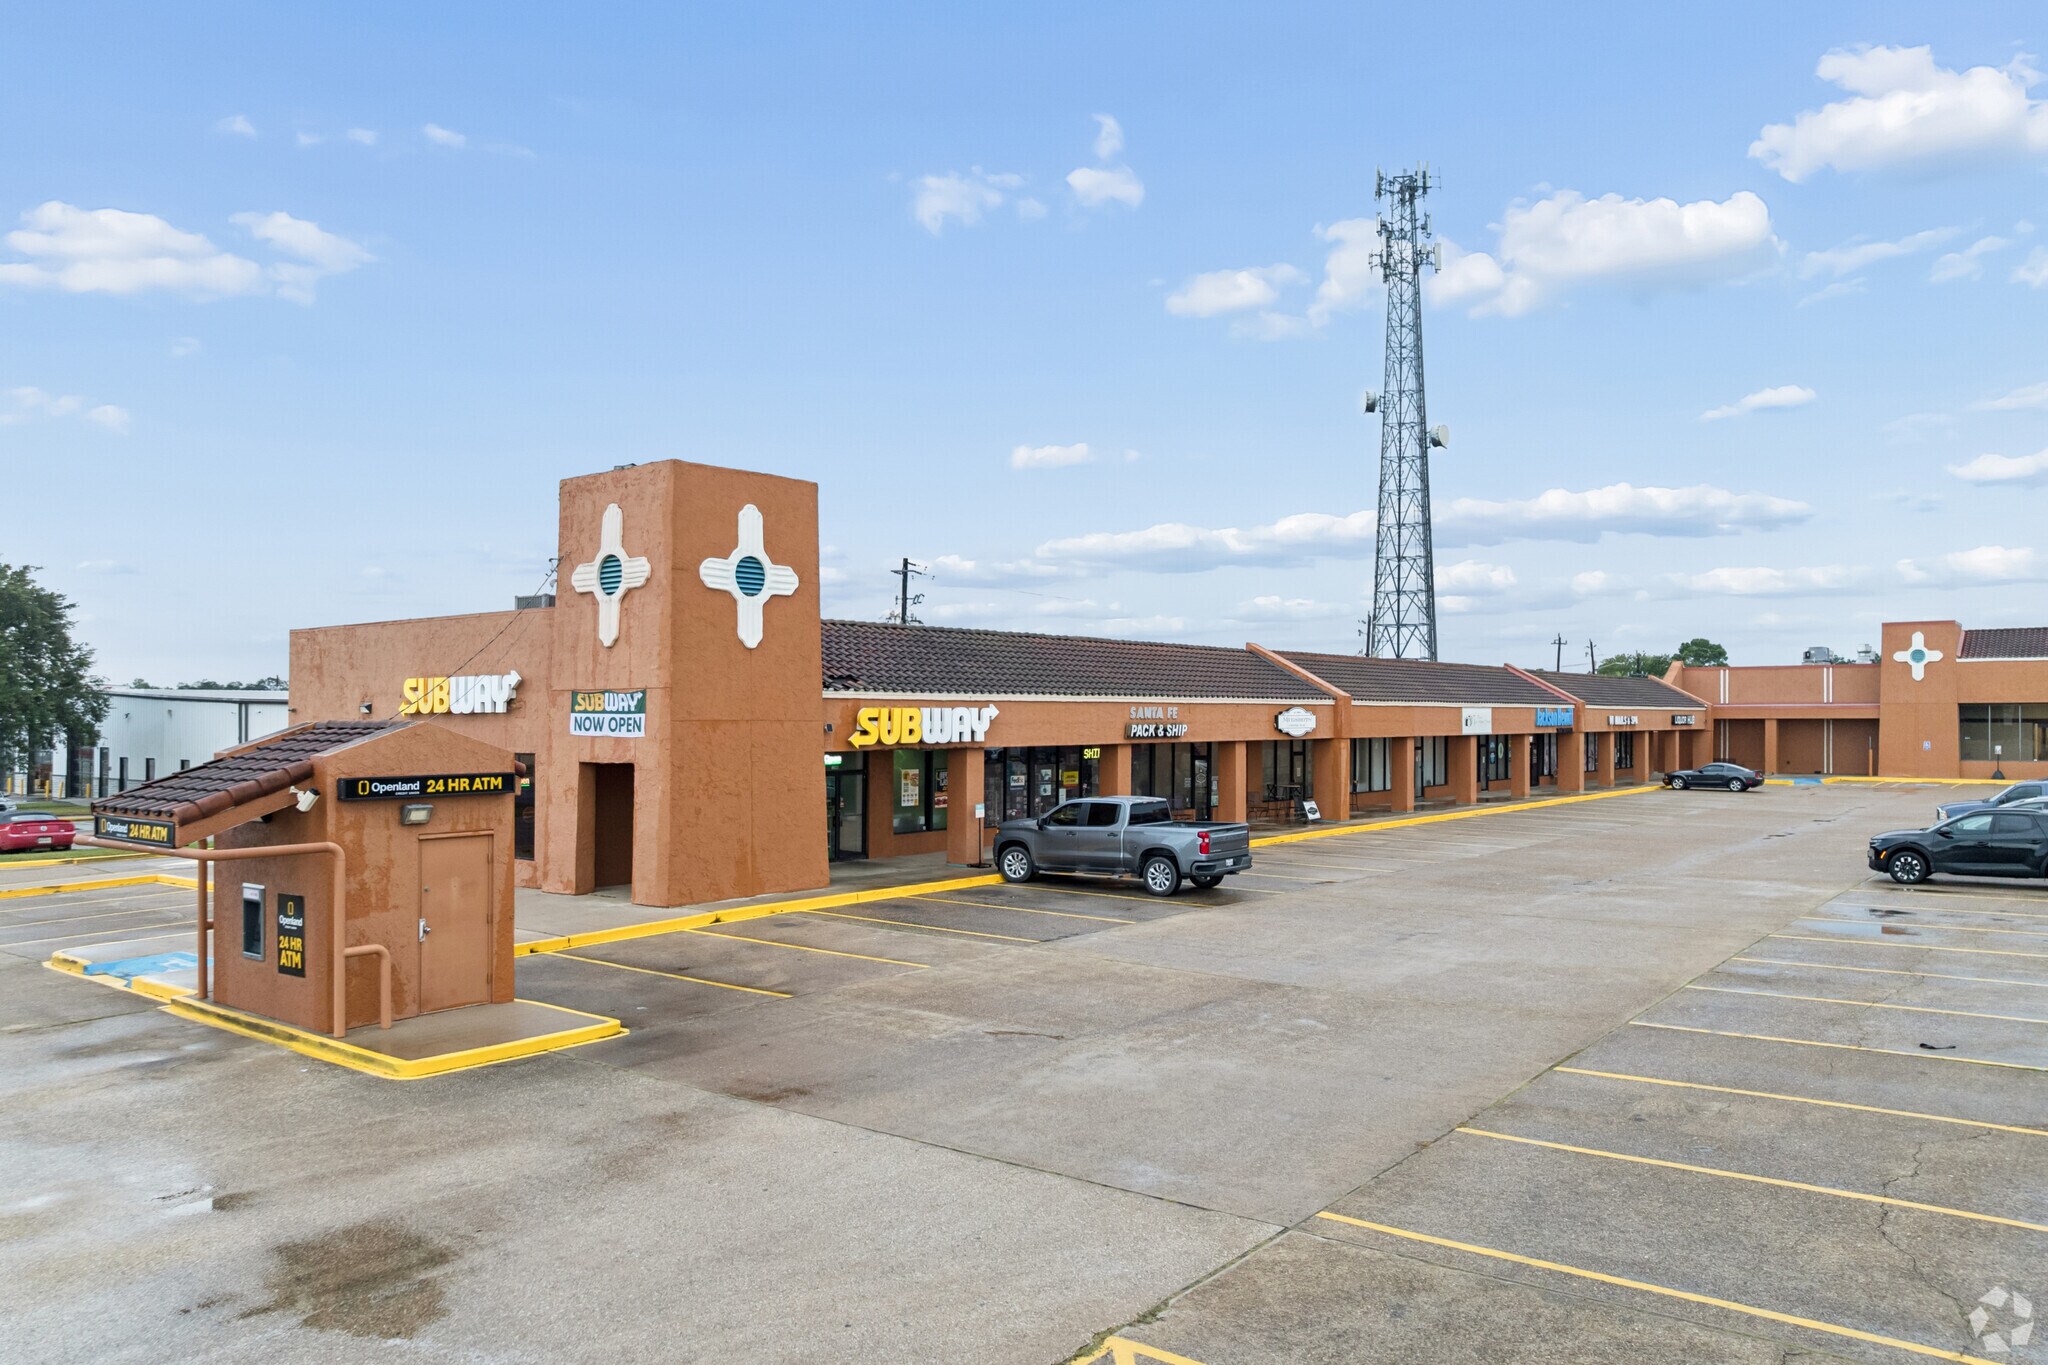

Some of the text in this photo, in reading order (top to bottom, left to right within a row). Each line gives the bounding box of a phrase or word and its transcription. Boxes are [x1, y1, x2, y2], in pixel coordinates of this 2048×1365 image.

[398, 670, 522, 717] SUBWAY
[574, 691, 643, 712] SUBWAY
[1130, 706, 1178, 719] SANTA FE
[574, 716, 641, 732] NOW OPEN
[848, 703, 1000, 749] SUBWAY
[1131, 723, 1188, 737] PACK & SHIP
[371, 776, 503, 794] Openland 24 HR ATM
[106, 821, 168, 842] Openland 24 HR ATM
[279, 914, 303, 927] Openland
[279, 935, 302, 952] 24 HR
[280, 949, 302, 969] ATM
